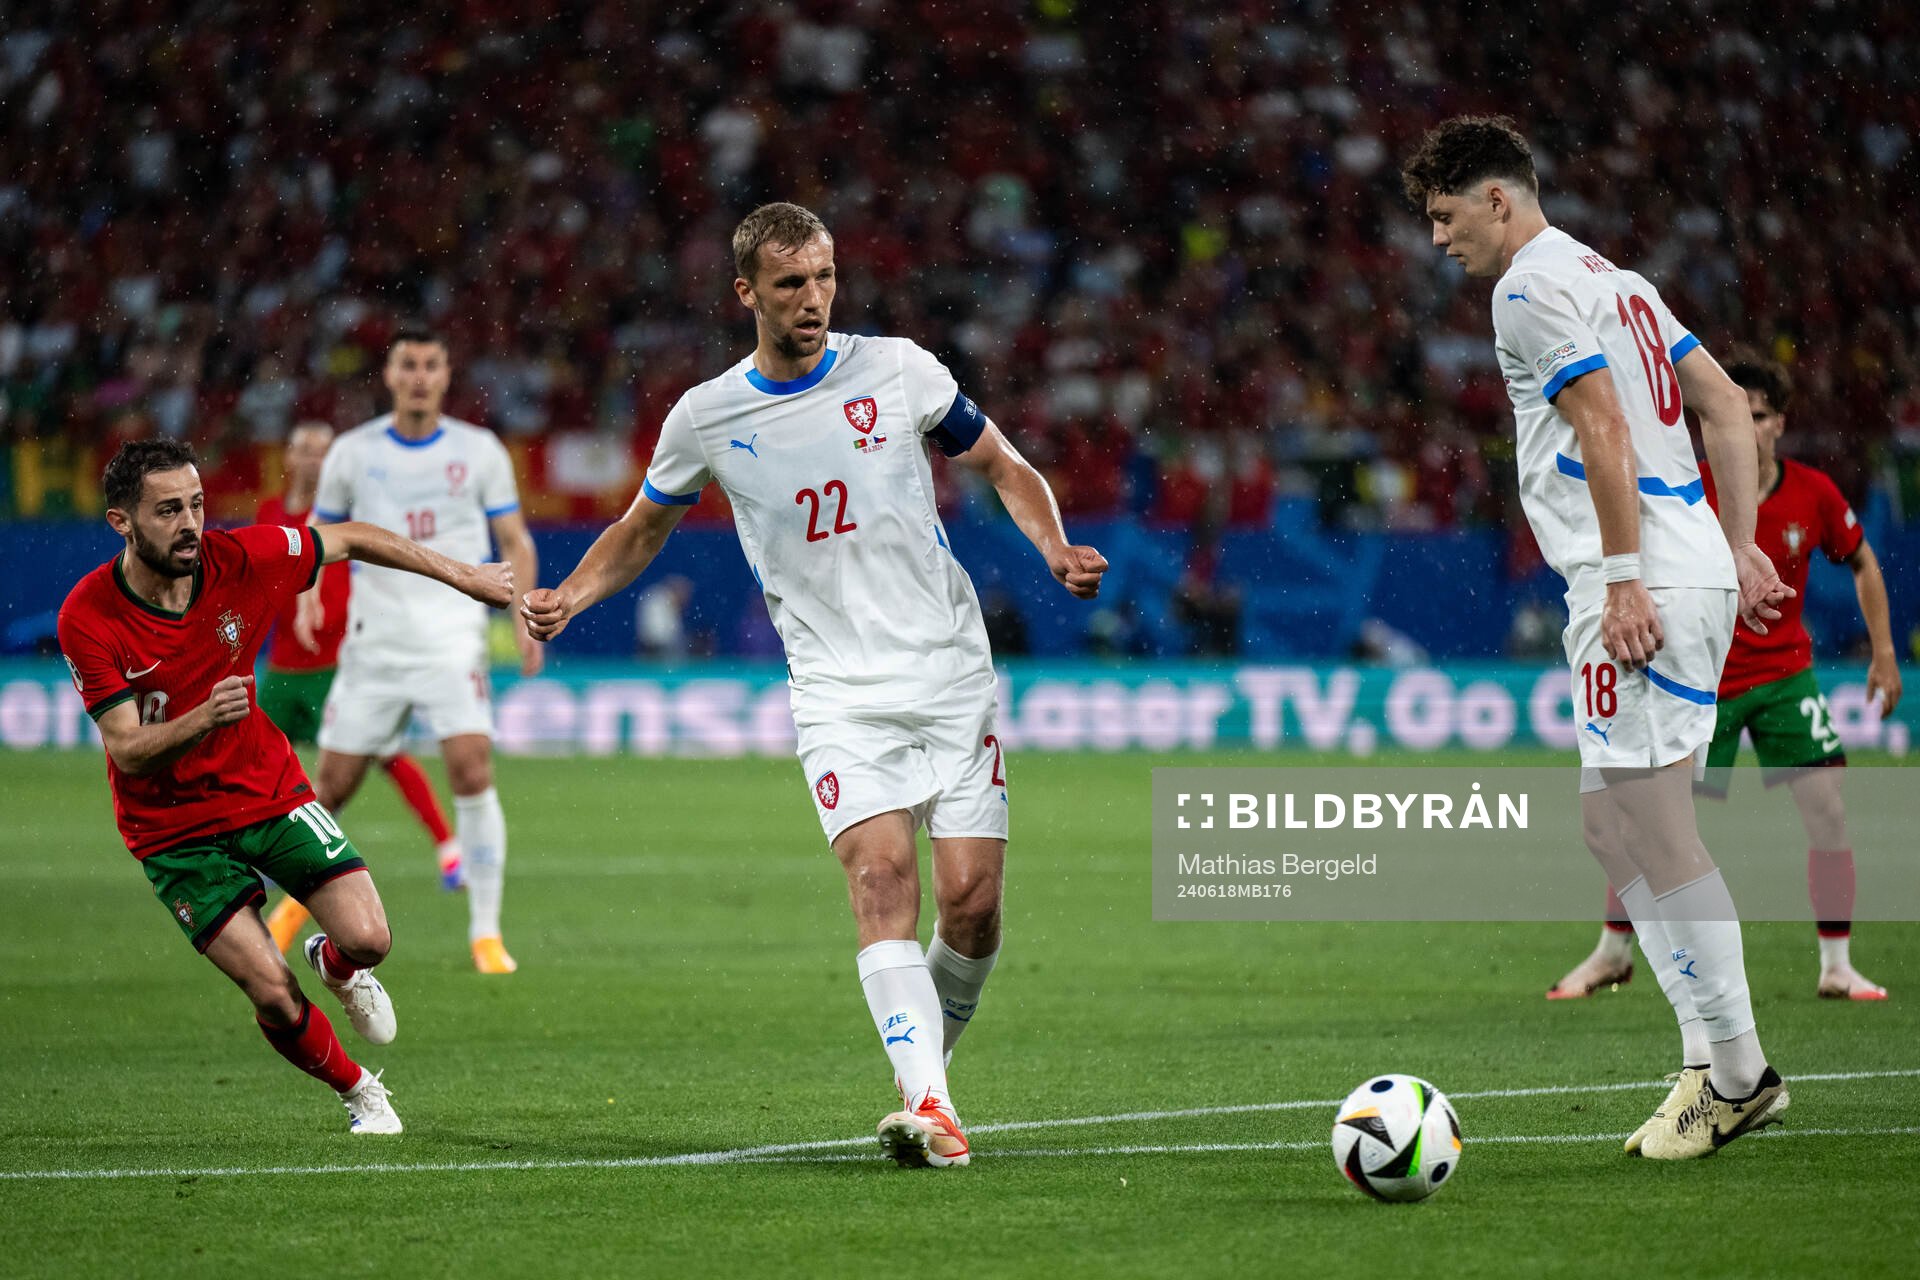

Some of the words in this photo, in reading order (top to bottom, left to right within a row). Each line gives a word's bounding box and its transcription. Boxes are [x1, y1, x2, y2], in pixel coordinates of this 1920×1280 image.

[1616, 292, 1682, 427] 18
[405, 508, 437, 541] 10
[795, 480, 857, 542] 22
[1581, 662, 1617, 718] 18
[984, 734, 1006, 787] 2
[288, 801, 345, 845] 10
[882, 1013, 908, 1033] CZE
